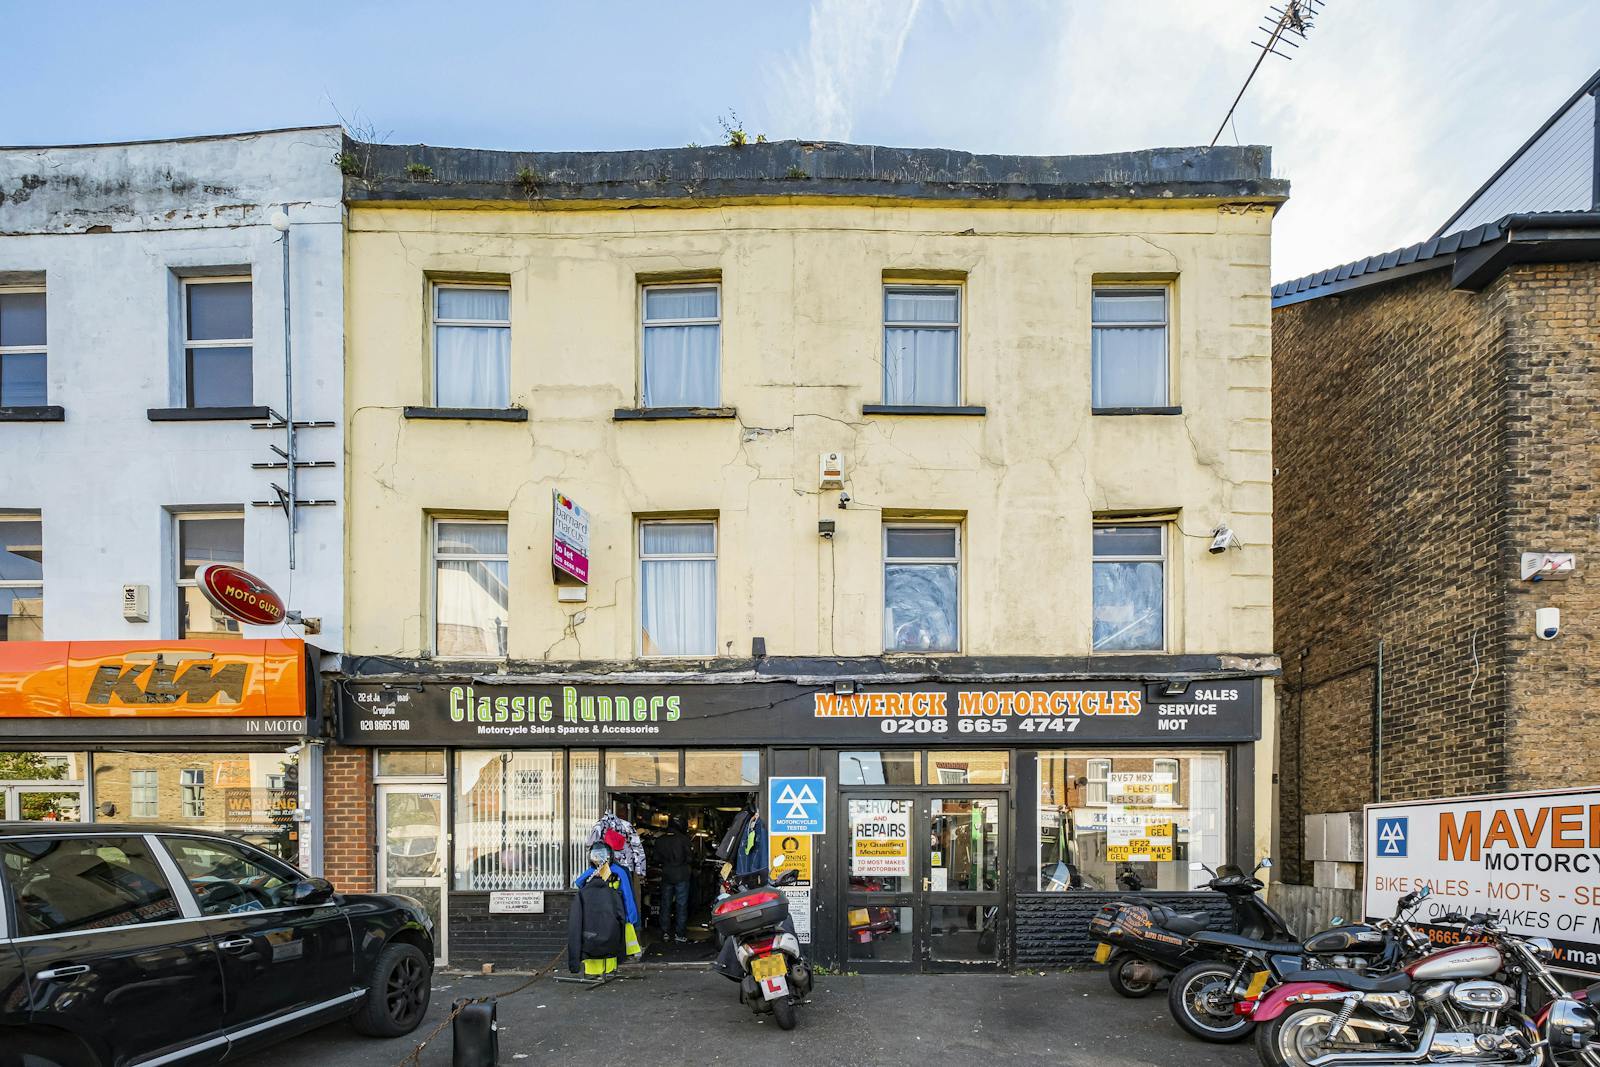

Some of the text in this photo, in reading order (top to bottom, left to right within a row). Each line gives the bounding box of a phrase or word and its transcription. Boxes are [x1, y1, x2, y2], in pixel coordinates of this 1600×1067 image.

[556, 503, 588, 535] barnard
[556, 518, 584, 543] marcus
[555, 542, 574, 561] to let
[225, 585, 281, 618] MOTO GUZZI
[86, 664, 248, 704] KTM
[1194, 689, 1239, 701] SALES
[372, 705, 396, 717] Croydon
[449, 686, 681, 724] Classic Runners
[814, 690, 1142, 718] MAVERICK MOTORCYCLES
[1157, 704, 1217, 716] SERVICE
[246, 720, 302, 732] IN MOTO
[360, 720, 374, 731] 020
[374, 720, 392, 731] 8665
[477, 725, 660, 736] Motorcycle Sales Spares & Accessories
[880, 718, 1081, 733] 0208 665 4747
[1157, 719, 1188, 730] MOT
[228, 798, 297, 810] WARNING
[857, 800, 906, 814] SERVICE
[856, 823, 906, 838] REPAIRS
[1151, 829, 1168, 837] GEL
[1375, 876, 1408, 892] BIKE
[1414, 878, 1469, 896] SALES
[1487, 882, 1551, 902] MOT's
[1429, 903, 1451, 918] ON
[1499, 908, 1550, 929] AKES
[1557, 914, 1587, 932] OF
[1428, 928, 1460, 945] 8665
[767, 980, 781, 993] L
